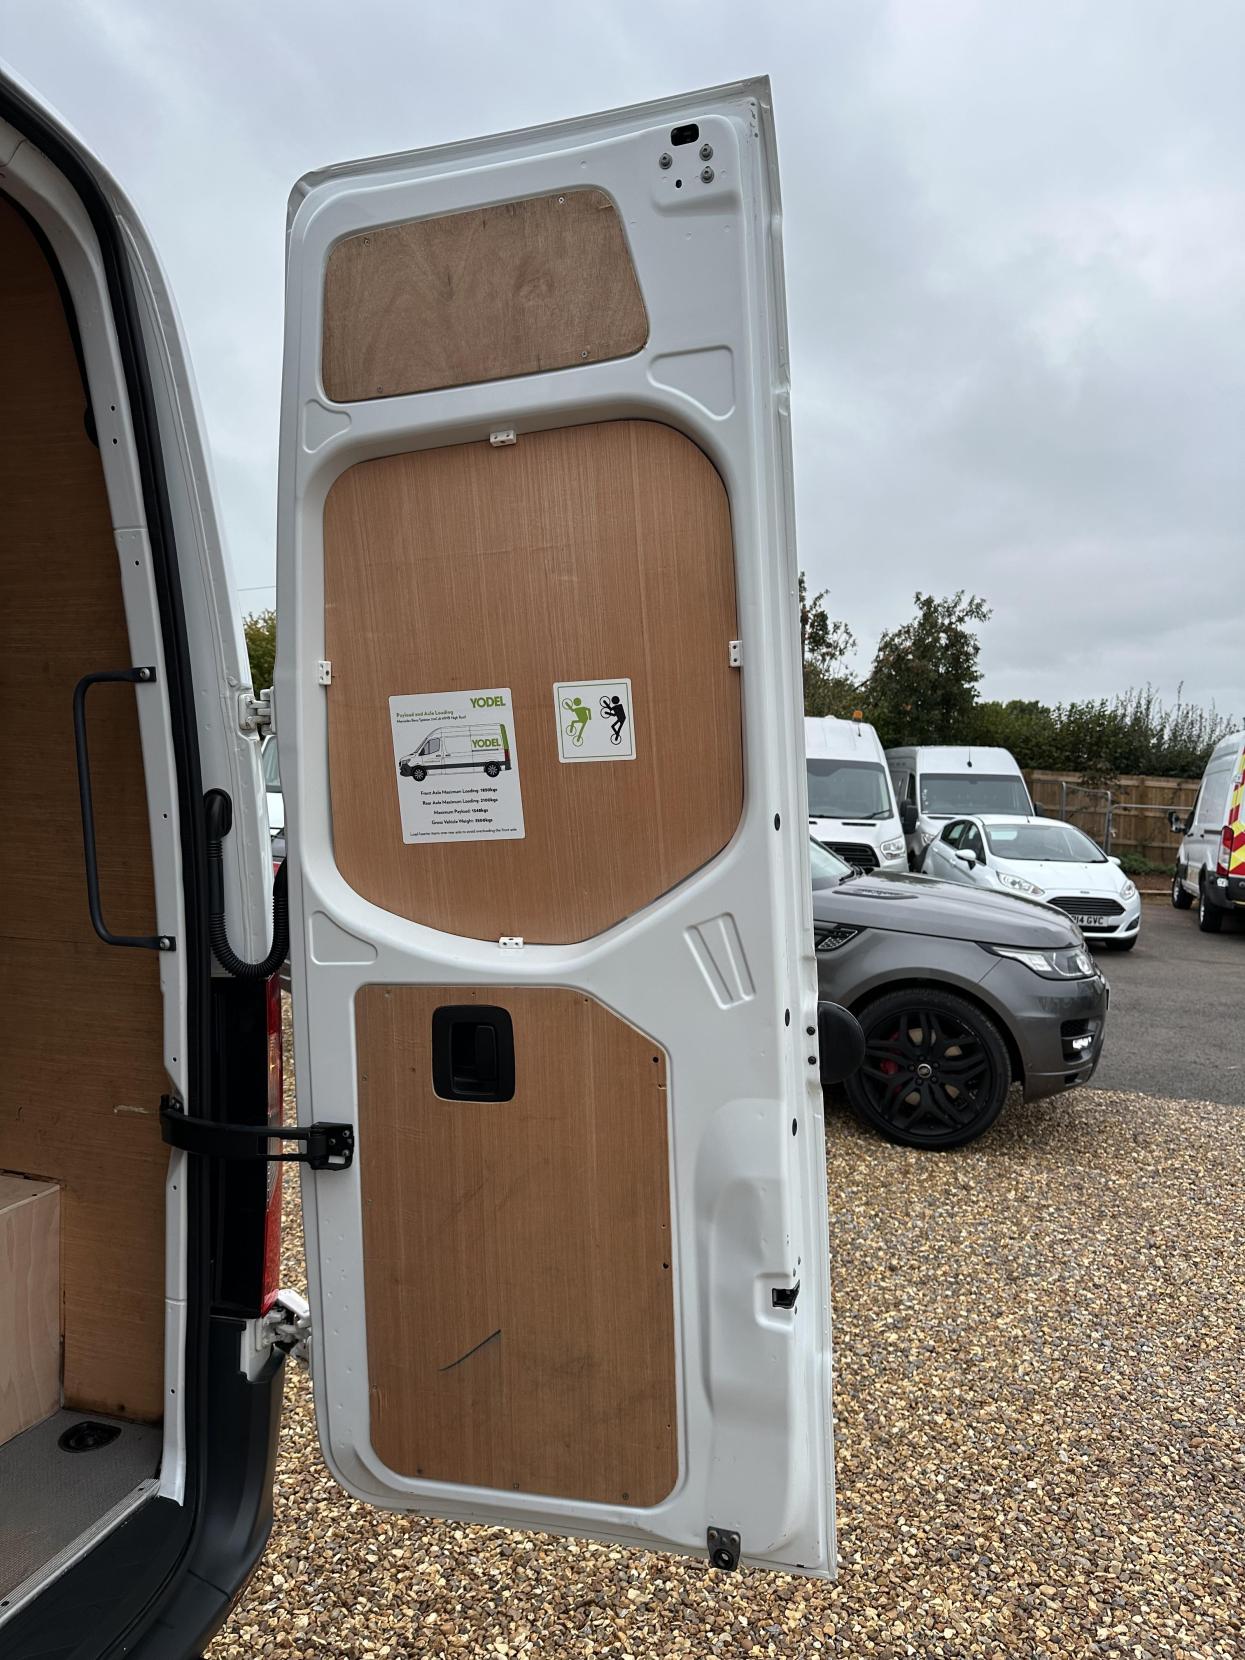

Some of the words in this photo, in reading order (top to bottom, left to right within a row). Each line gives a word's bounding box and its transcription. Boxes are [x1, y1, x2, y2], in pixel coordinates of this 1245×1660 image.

[470, 696, 506, 708] YODEL
[472, 738, 501, 748] YODEL
[1087, 916, 1104, 925] GVC
